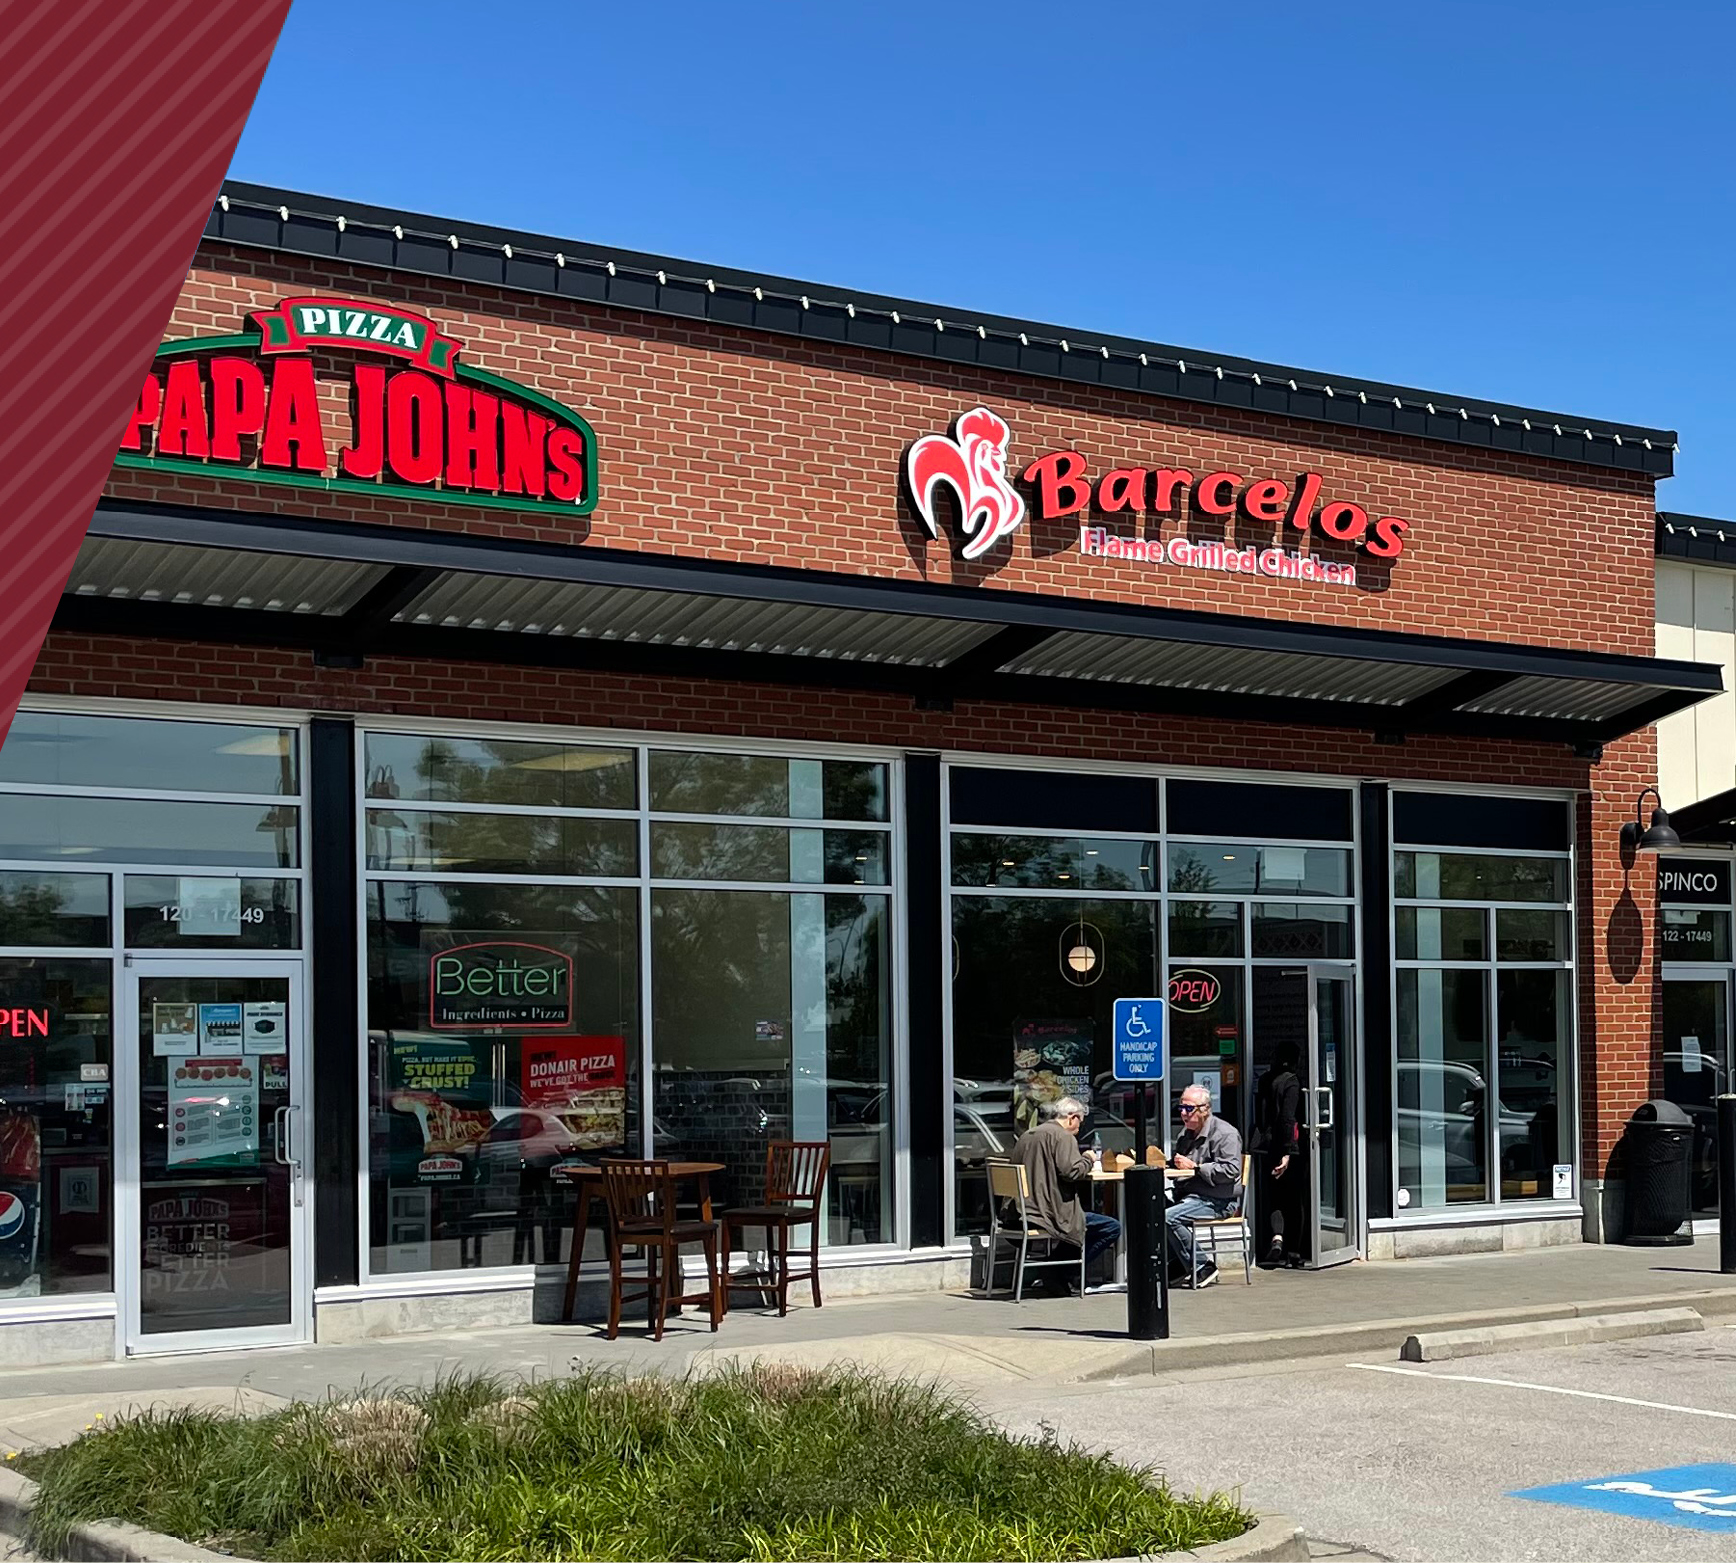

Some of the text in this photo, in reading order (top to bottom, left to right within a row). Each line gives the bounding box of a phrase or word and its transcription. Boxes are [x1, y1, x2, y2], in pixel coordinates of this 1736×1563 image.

[300, 307, 418, 349] PIZZA
[342, 363, 583, 501] JOHN'S
[1023, 450, 1410, 558] Barcelos
[1080, 527, 1356, 585] Flame Grilled Chicken
[159, 905, 192, 922] 120
[210, 906, 264, 924] 17449
[1663, 930, 1679, 941] 122
[1686, 930, 1712, 942] 17449
[436, 958, 566, 997] Better
[1168, 981, 1215, 1002] OPEN
[442, 1007, 565, 1021] Ingredients Pizza
[1120, 1042, 1158, 1052] HANDICAP
[1123, 1052, 1155, 1062] PARKING
[404, 1063, 476, 1076] STUFFED
[530, 1055, 615, 1077] DONAIR PIZZA
[1063, 1066, 1089, 1075] WHOLE
[1129, 1064, 1149, 1074] ONLY
[410, 1075, 470, 1089] CRUST!
[573, 1072, 588, 1082] THE
[1056, 1075, 1089, 1084] CHICKEN
[145, 1270, 230, 1293] PIZZA
